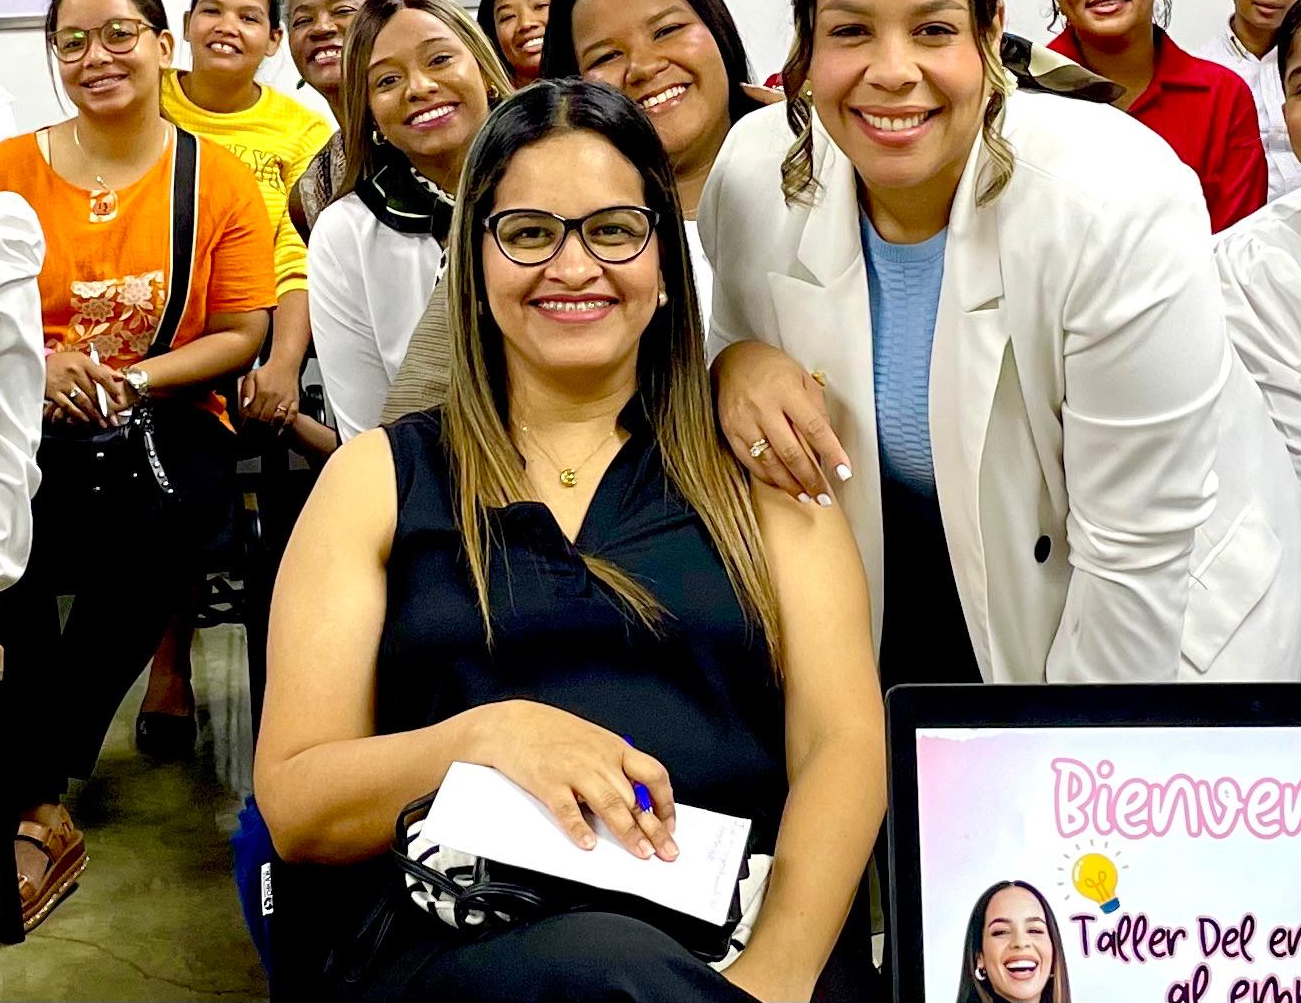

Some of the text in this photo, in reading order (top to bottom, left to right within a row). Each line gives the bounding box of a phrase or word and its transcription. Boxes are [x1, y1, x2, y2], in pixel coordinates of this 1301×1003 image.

[1070, 912, 1187, 961] Taller
[1199, 912, 1256, 961] Del
[1167, 964, 1210, 1003] al
